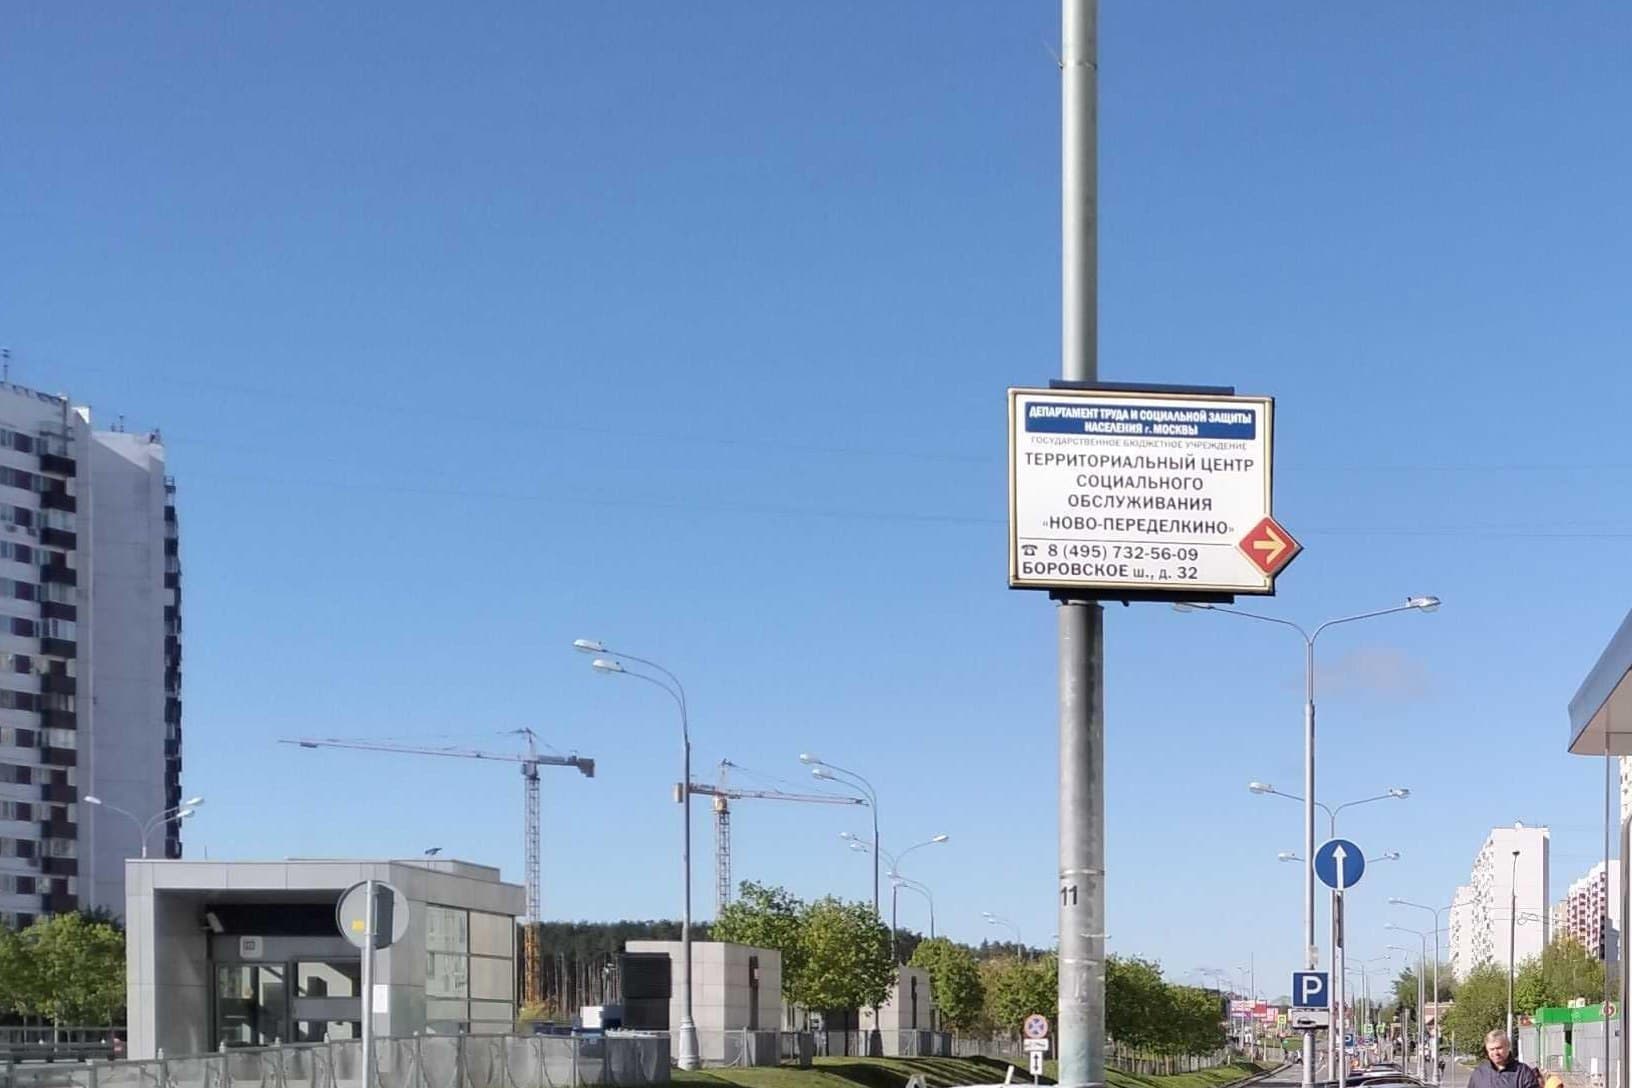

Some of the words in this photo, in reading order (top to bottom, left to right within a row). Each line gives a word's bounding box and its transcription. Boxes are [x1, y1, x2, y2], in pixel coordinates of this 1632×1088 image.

[1029, 406, 1099, 419] ДЕПАРТАМЕНТ
[1100, 408, 1128, 420] ТРУДА
[1131, 410, 1138, 420] И
[1140, 409, 1206, 422] СОЦИАЛЬНОЙ
[1208, 413, 1252, 425] ЗАЩИТЫ
[1084, 421, 1143, 434] НАСЕЛЕНИЯ
[1153, 424, 1198, 436] МОСКВЫ
[1031, 436, 1120, 447] ГОСУДАРСТВЕННОЕ
[1123, 439, 1183, 448] БЮДЖЕТНОЕ
[1185, 441, 1247, 450] УЧРЕЖДЕНИЕ
[1025, 452, 1195, 470] ТЕРРИТОРИАЛЬНЫЙ
[1201, 458, 1254, 473] ЦЕНТР
[1076, 474, 1203, 490] СОЦИАЛЬНОГО
[1068, 494, 1212, 511] ОБСЛУЖИВАНИЯ
[1043, 516, 1234, 535] «НОВО-ПЕРЕДЕЛКИНО»
[1048, 544, 1058, 556] 8
[1063, 544, 1107, 560] (495)
[1112, 546, 1199, 561] 732-56-09
[1022, 561, 1128, 577] БОРОВСКОЕ
[1159, 570, 1172, 580] д.
[1177, 567, 1198, 580] 32
[1061, 885, 1078, 906] 11
[1302, 975, 1322, 1004] P
